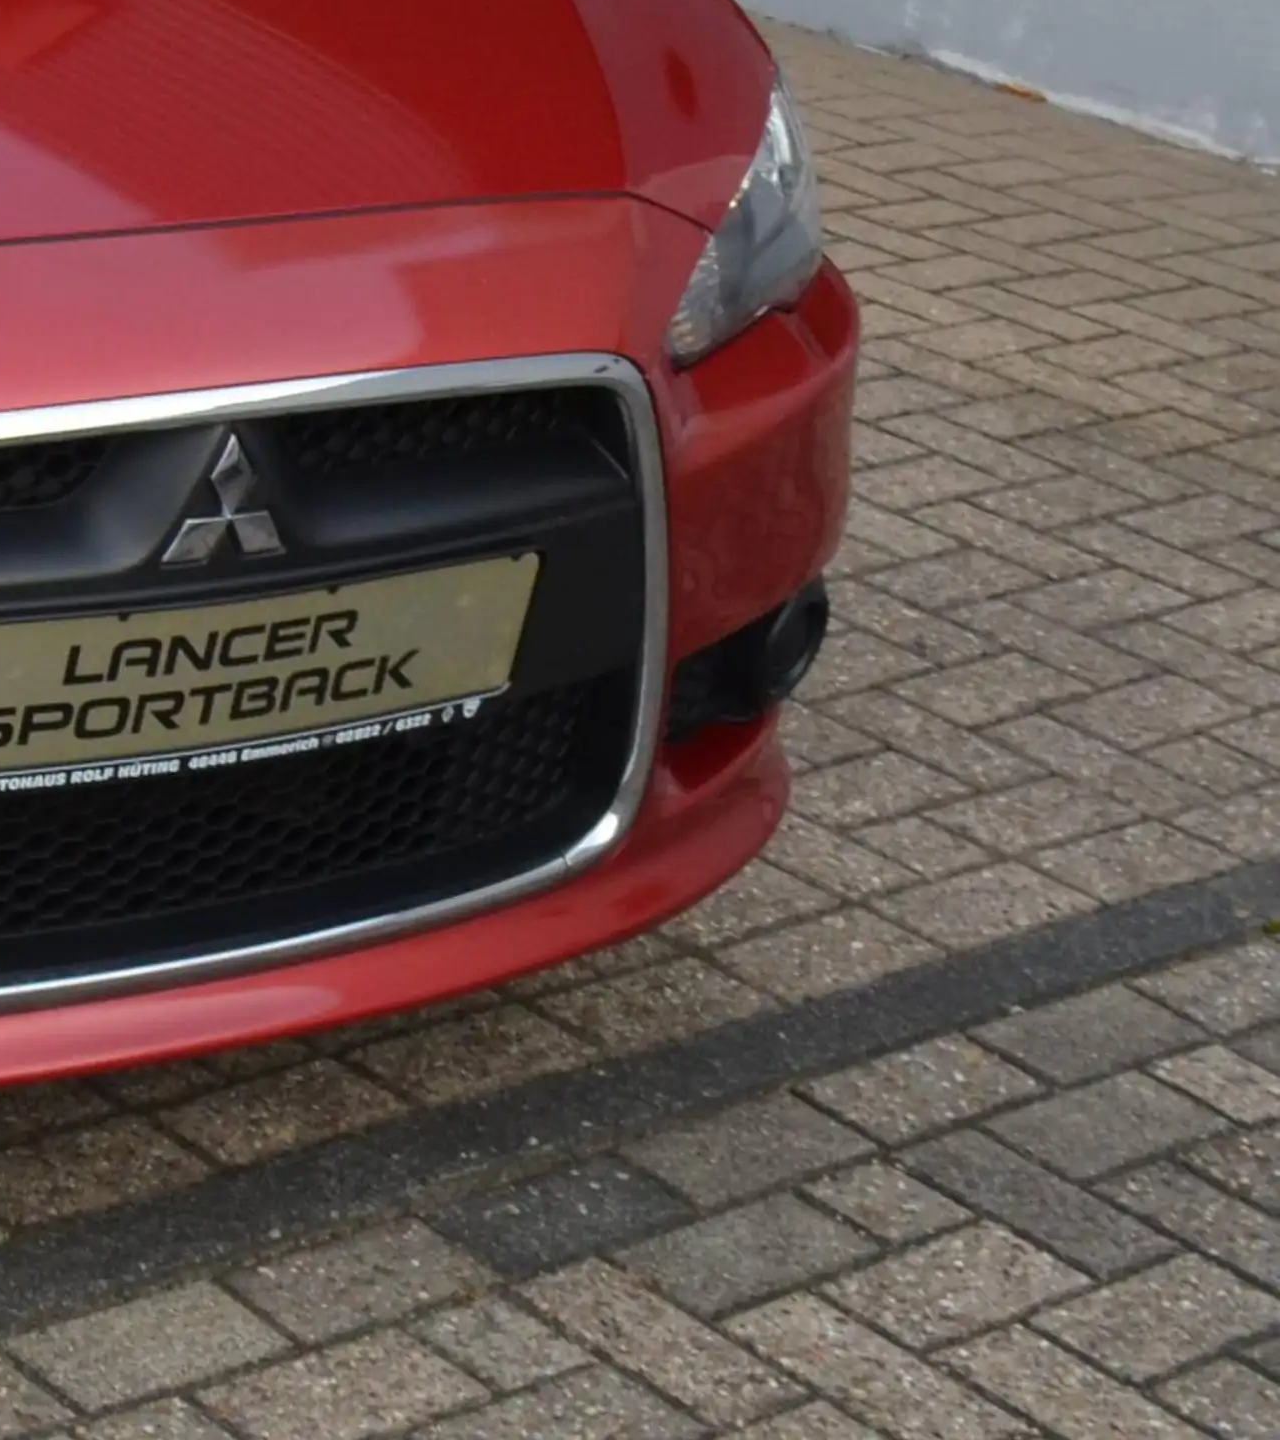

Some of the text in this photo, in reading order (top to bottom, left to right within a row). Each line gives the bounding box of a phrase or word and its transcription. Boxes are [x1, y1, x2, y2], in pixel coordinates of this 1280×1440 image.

[62, 608, 359, 686] LANCER
[70, 766, 115, 785] ROLF
[117, 759, 181, 779] HÜTING
[241, 737, 320, 761] Emmerich
